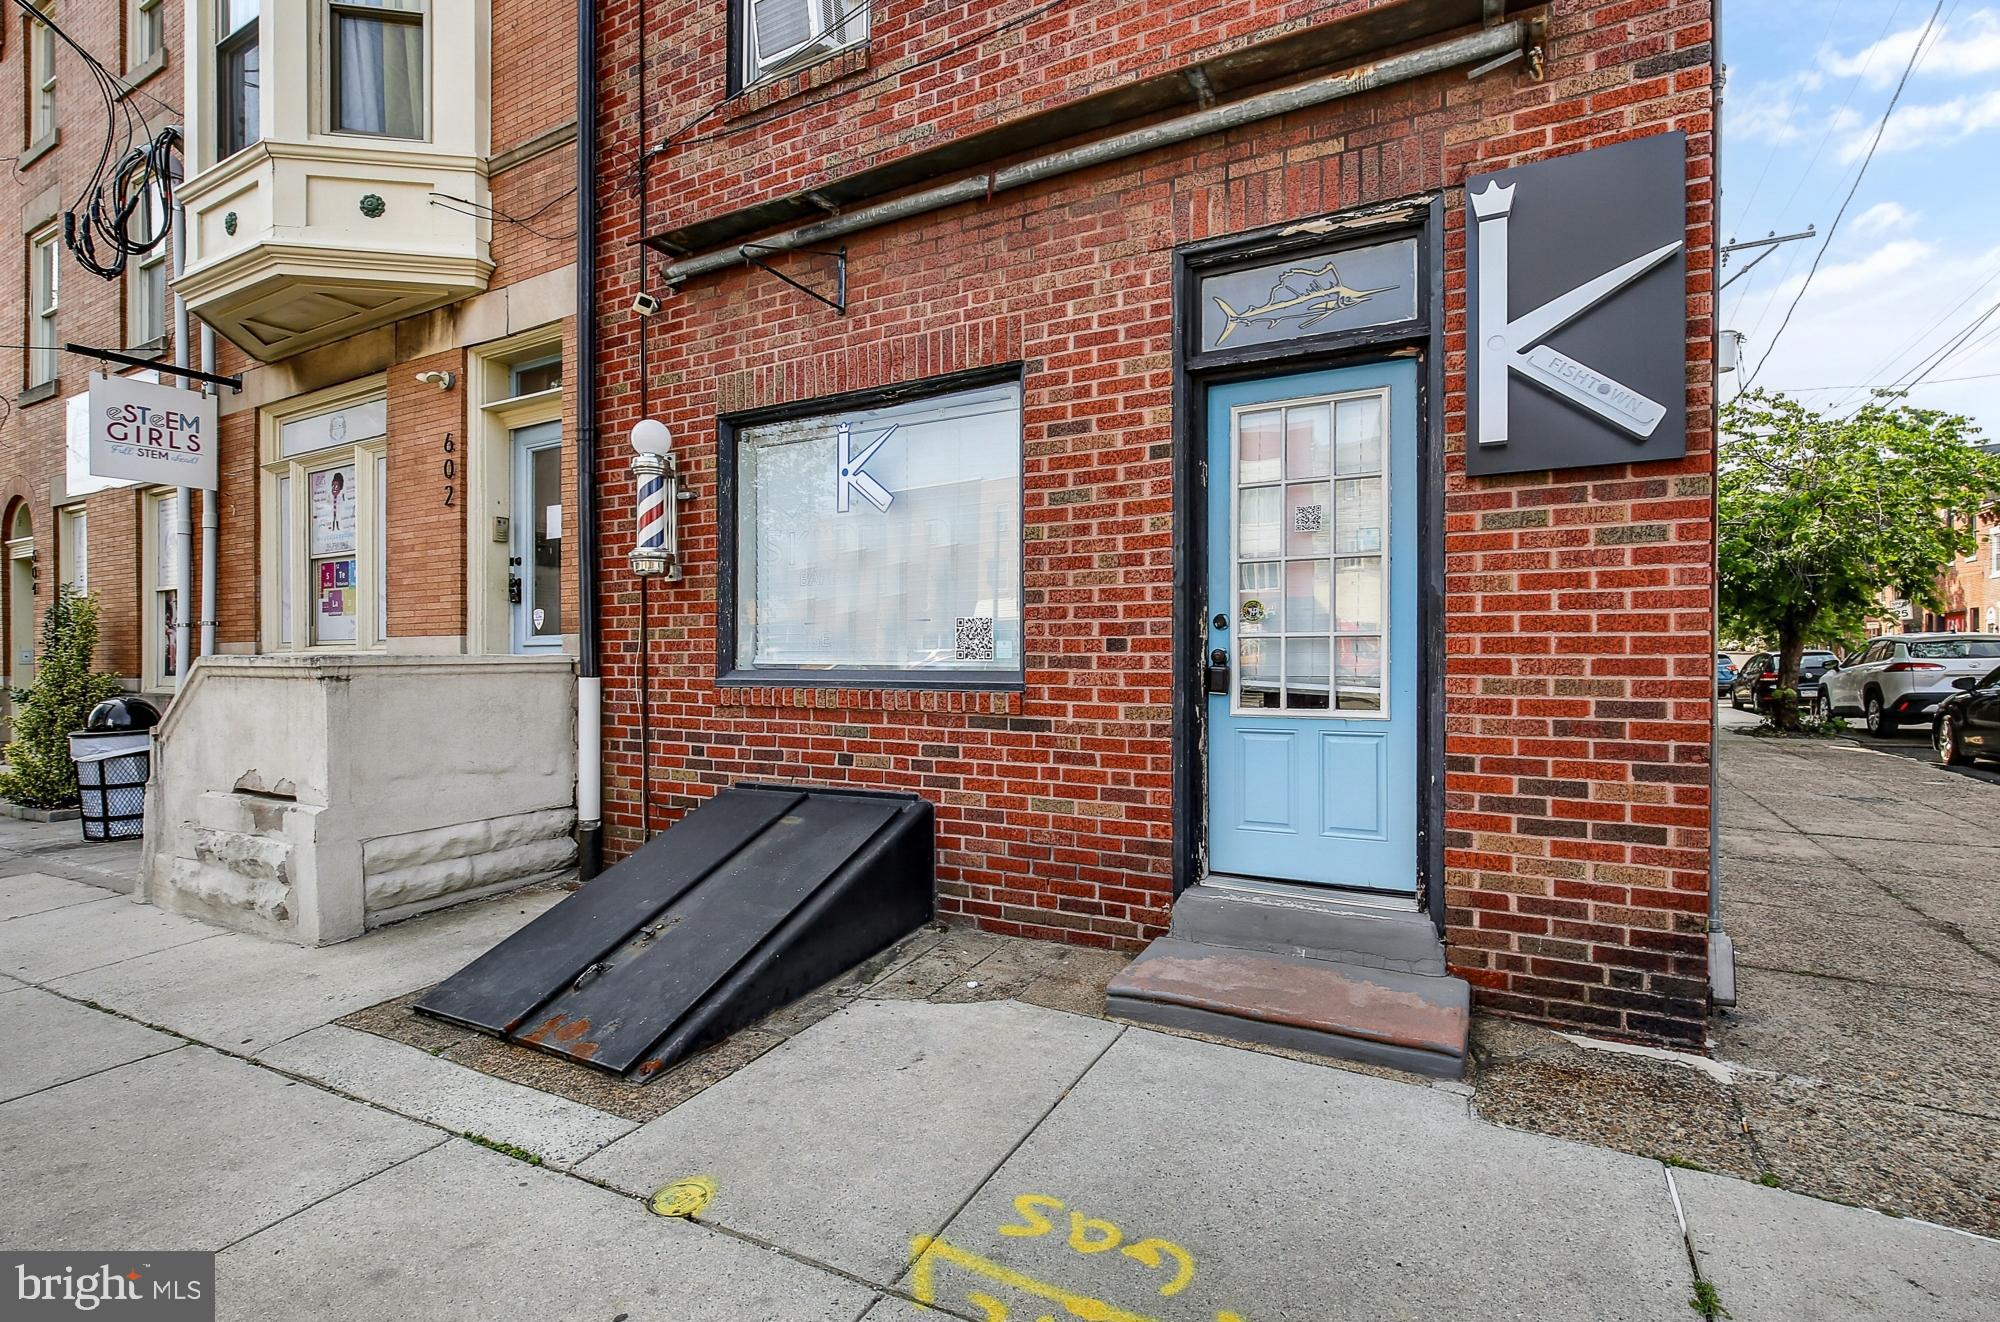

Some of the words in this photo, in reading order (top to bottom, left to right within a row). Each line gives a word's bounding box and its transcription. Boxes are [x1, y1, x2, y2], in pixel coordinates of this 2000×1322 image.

[1478, 215, 1684, 448] K
[1548, 356, 1645, 414] FISHTOWN
[106, 422, 201, 452] GIRLS
[137, 448, 169, 461] STEM
[443, 432, 456, 508] 602
